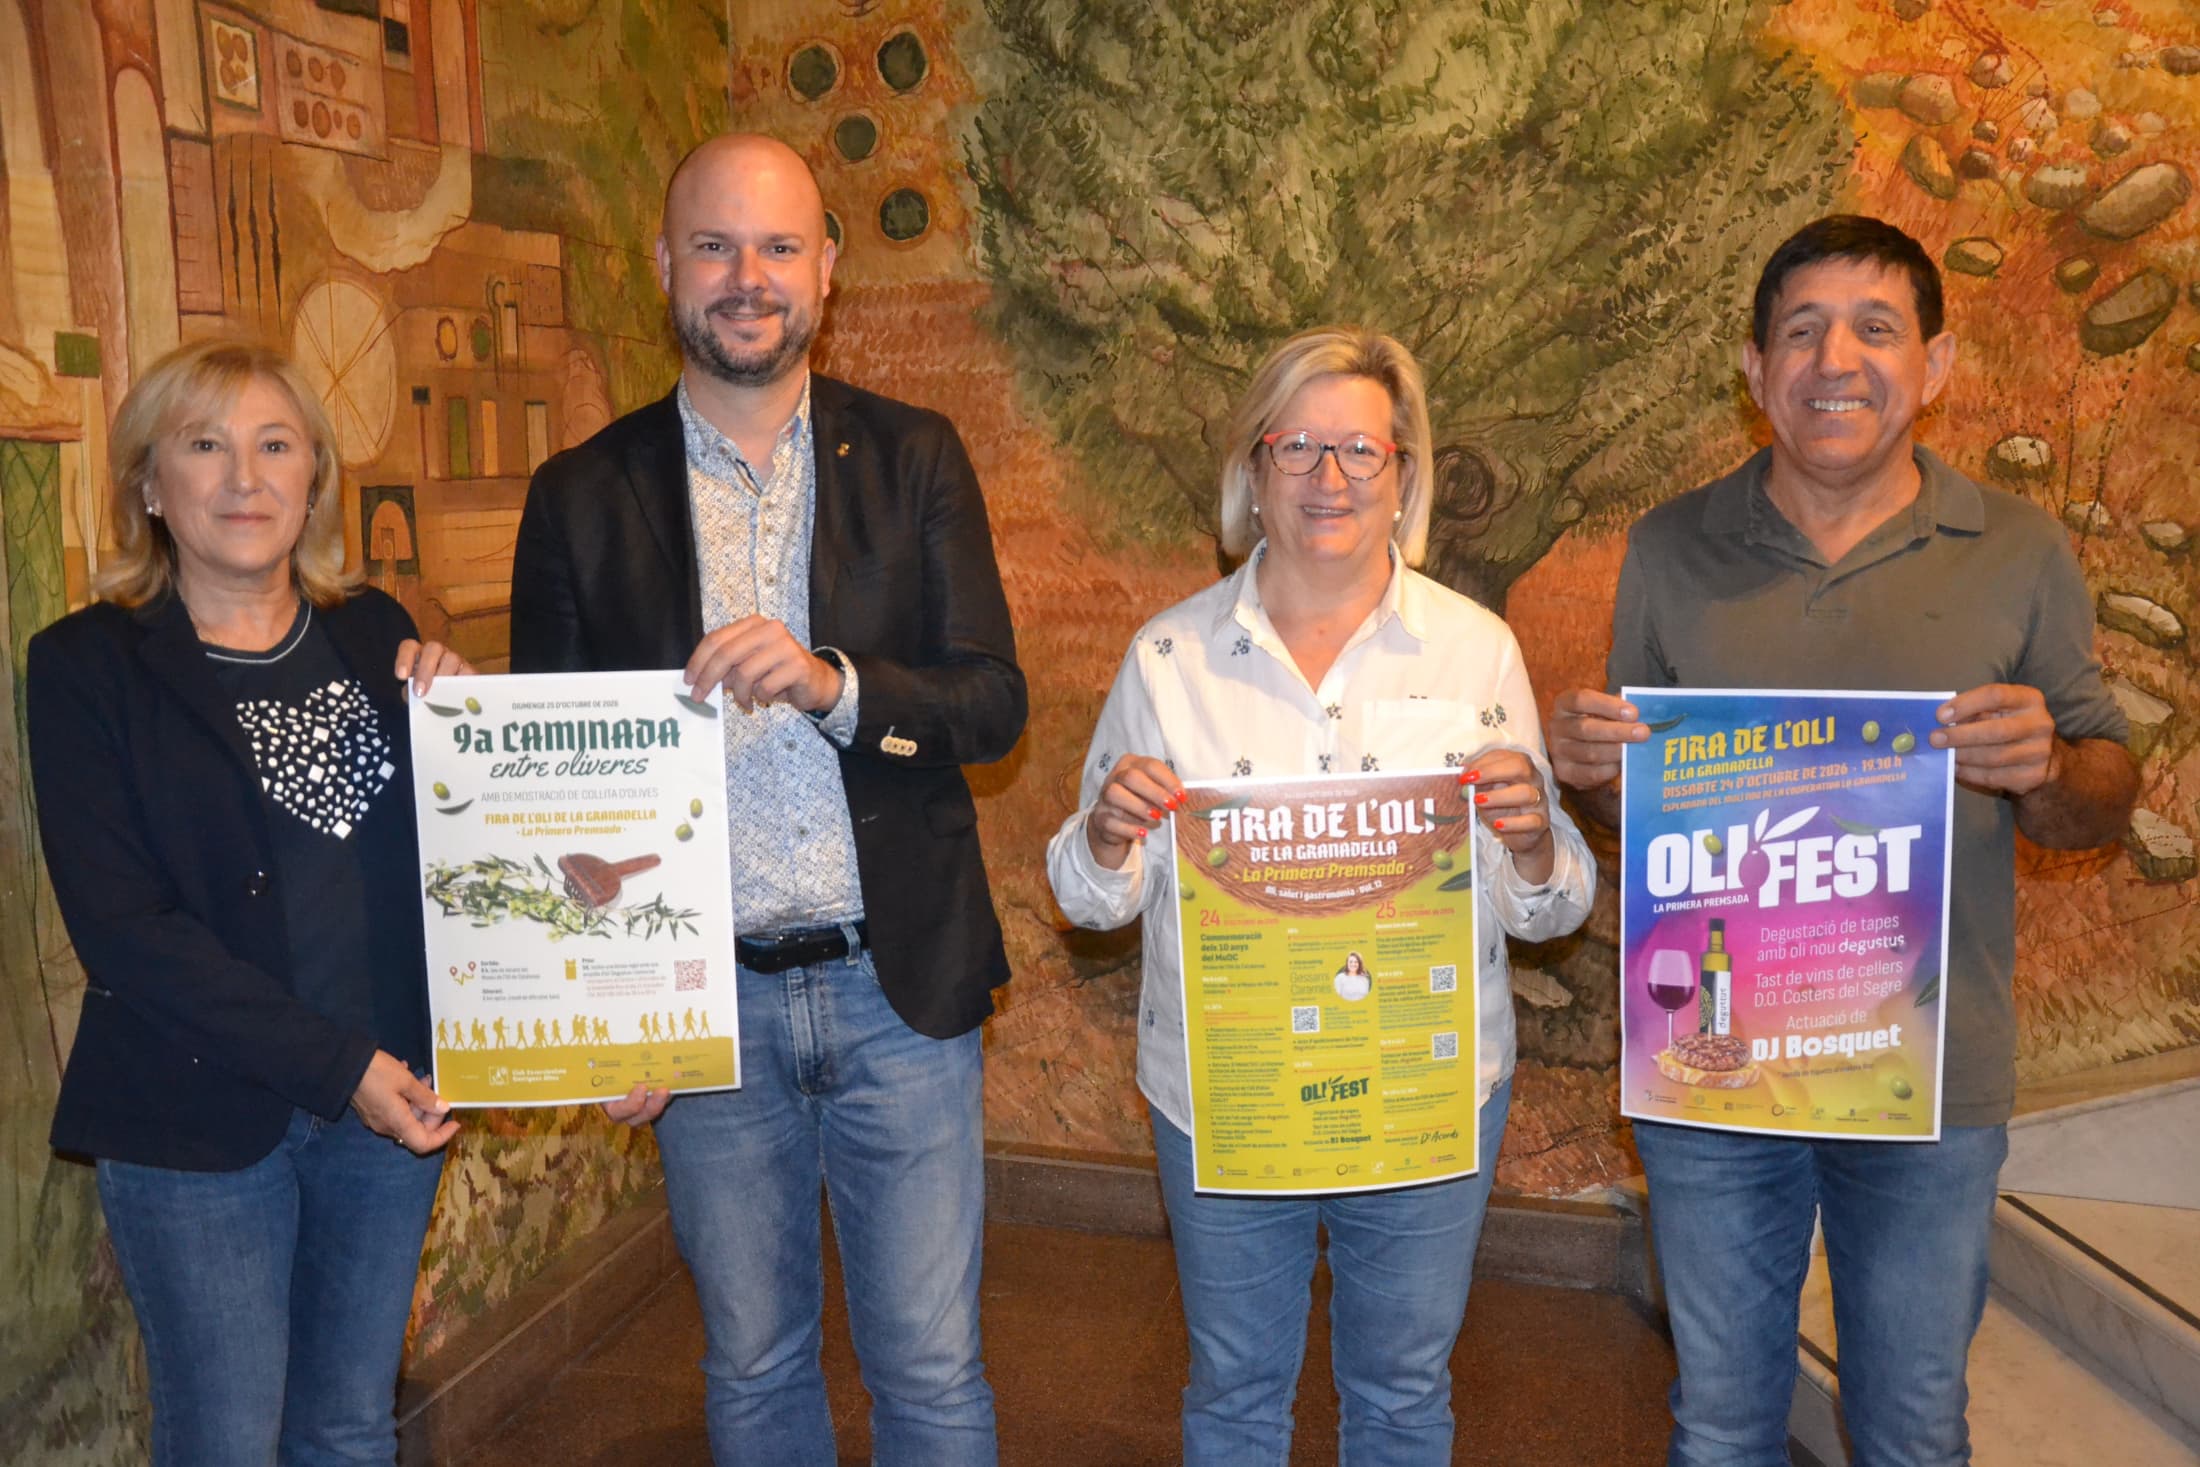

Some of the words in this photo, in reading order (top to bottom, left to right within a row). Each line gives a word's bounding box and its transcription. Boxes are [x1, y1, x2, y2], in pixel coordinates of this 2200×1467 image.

[502, 717, 681, 752] CAMINADA
[1664, 731, 1727, 765] FIRA
[1733, 725, 1768, 755] DE
[1774, 716, 1835, 750] L'OLI
[489, 754, 549, 778] entre
[555, 750, 649, 776] oliveres
[1663, 769, 1677, 782] DE
[1680, 767, 1694, 780] LA
[1697, 756, 1774, 777] GRANADELLA
[1663, 780, 1717, 799] DISSABTE
[1720, 779, 1734, 791] 24
[1736, 768, 1800, 789] D'OCTUBRE
[1802, 766, 1817, 779] DE
[1819, 762, 1848, 777] 2026
[481, 791, 501, 802] AMB
[502, 789, 566, 802] DEMOSTRACIÓ
[567, 789, 579, 801] DE
[579, 788, 618, 800] COLLITA
[618, 787, 659, 800] D'OLIVES
[484, 812, 510, 825] FIRA
[512, 812, 526, 824] DE
[528, 811, 551, 823] L'OLI
[554, 811, 567, 823] DE
[570, 811, 583, 822] LA
[585, 808, 657, 822] GRANADELLA
[1209, 805, 1295, 845] FIRA
[1303, 802, 1351, 840] DE
[1357, 798, 1436, 836] L'OLI
[521, 827, 533, 837] La
[535, 826, 573, 837] Primera
[574, 824, 622, 836] Premsada
[1250, 847, 1271, 863] DE
[1273, 845, 1293, 861] LA
[1296, 840, 1398, 861] GRANADELLA
[1242, 868, 1261, 883] La
[1263, 865, 1326, 882] Primera
[1327, 860, 1406, 879] Premsada
[1375, 900, 1397, 919] 25
[1653, 904, 1664, 913] LA
[1665, 899, 1702, 912] PRIMERA
[1703, 894, 1749, 908] PREMSADA
[1199, 908, 1220, 928] 24
[1760, 921, 1836, 945] Degustació
[1840, 919, 1856, 935] de
[1860, 915, 1900, 934] tapes
[1756, 947, 1787, 962] amb
[1789, 944, 1807, 959] oli
[1809, 943, 1836, 957] nou
[1838, 934, 1905, 955] degustus
[1755, 972, 1782, 989] Tast
[1785, 969, 1802, 985] de
[1805, 966, 1834, 983] vins
[1837, 964, 1855, 981] de
[1857, 960, 1904, 979] cellers
[1754, 992, 1779, 1008] D.O.
[1782, 987, 1835, 1005] Costers
[1839, 982, 1860, 999] del
[1862, 979, 1903, 999] Segre
[1785, 1013, 1847, 1032] Actuació
[1849, 1010, 1867, 1025] de
[1751, 1036, 1779, 1062] DJ
[1785, 1023, 1902, 1060] Bosquet
